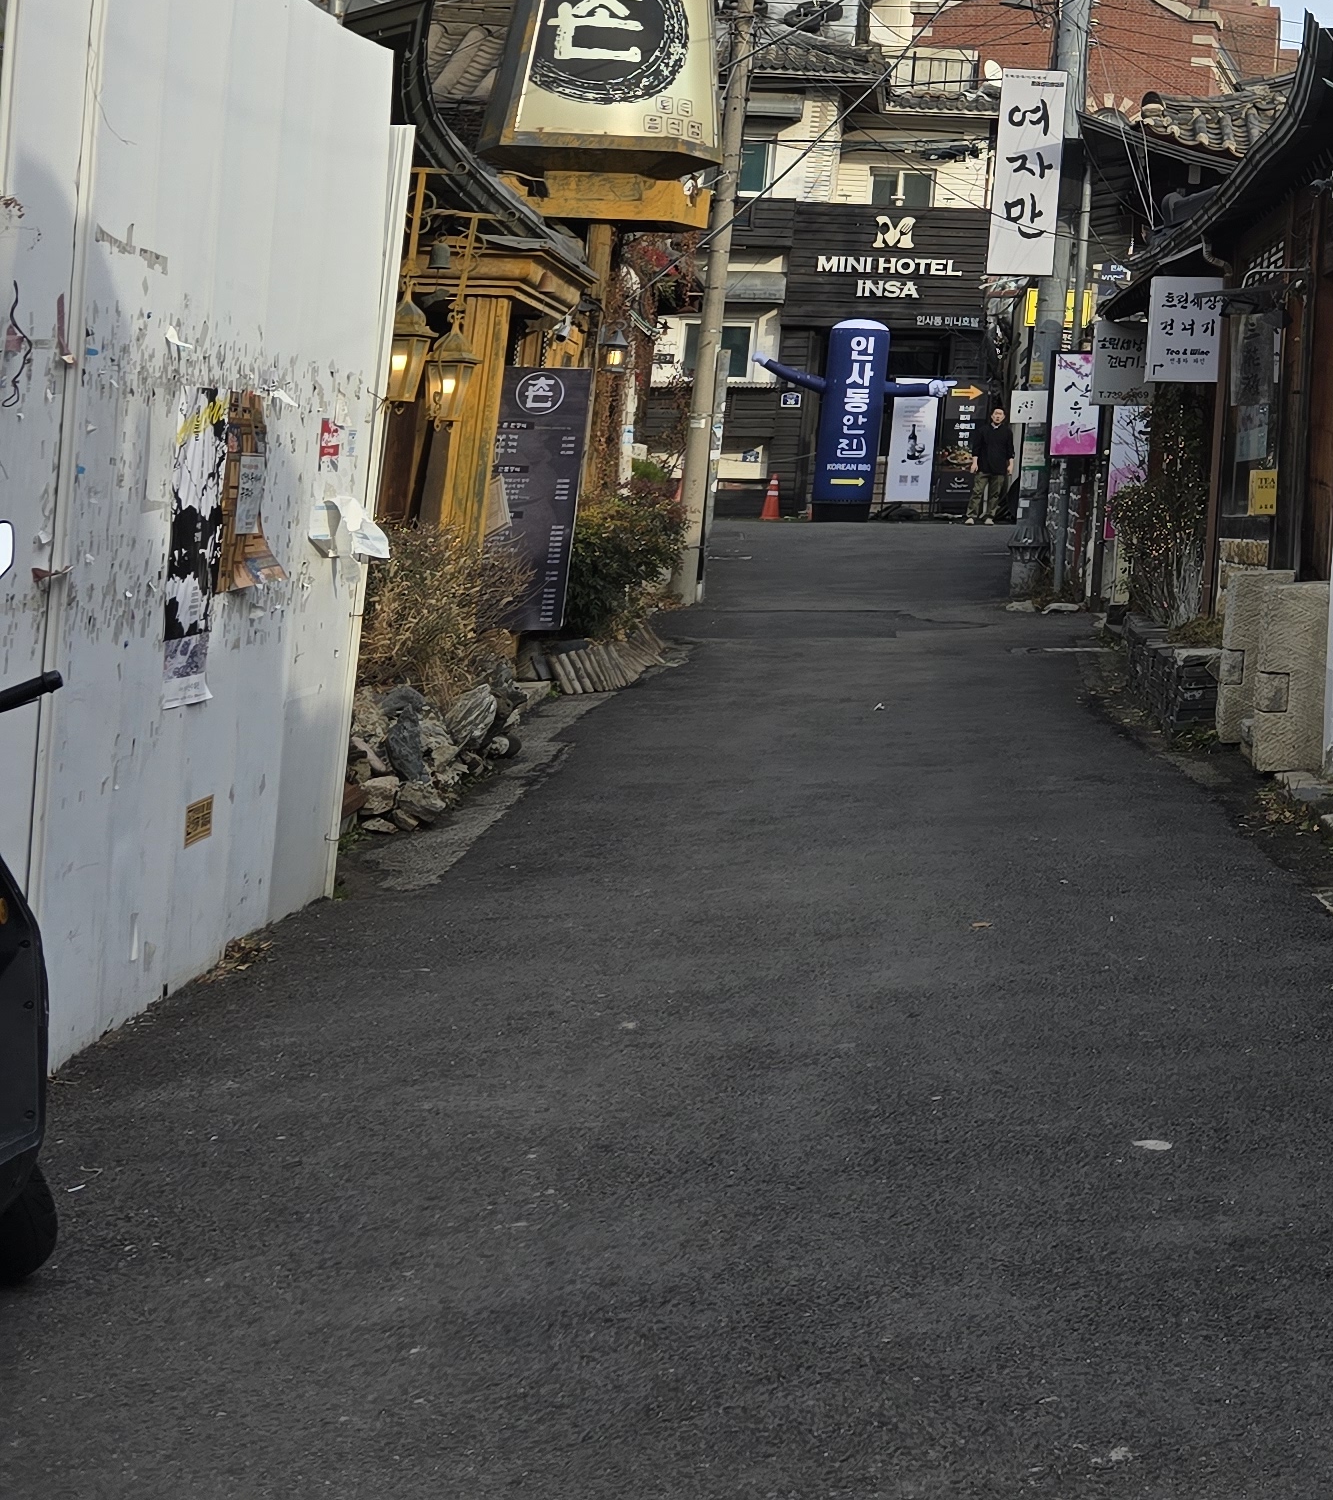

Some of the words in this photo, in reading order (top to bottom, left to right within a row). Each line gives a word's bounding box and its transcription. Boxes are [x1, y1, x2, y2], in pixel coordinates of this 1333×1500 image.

[1004, 99, 1053, 239] 여자만
[817, 256, 874, 273] MINI
[878, 257, 962, 276] HOTEL
[856, 280, 919, 298] INSA
[917, 316, 942, 325] 인사동
[945, 317, 979, 327] 미니호텔
[844, 337, 875, 412] 인사동
